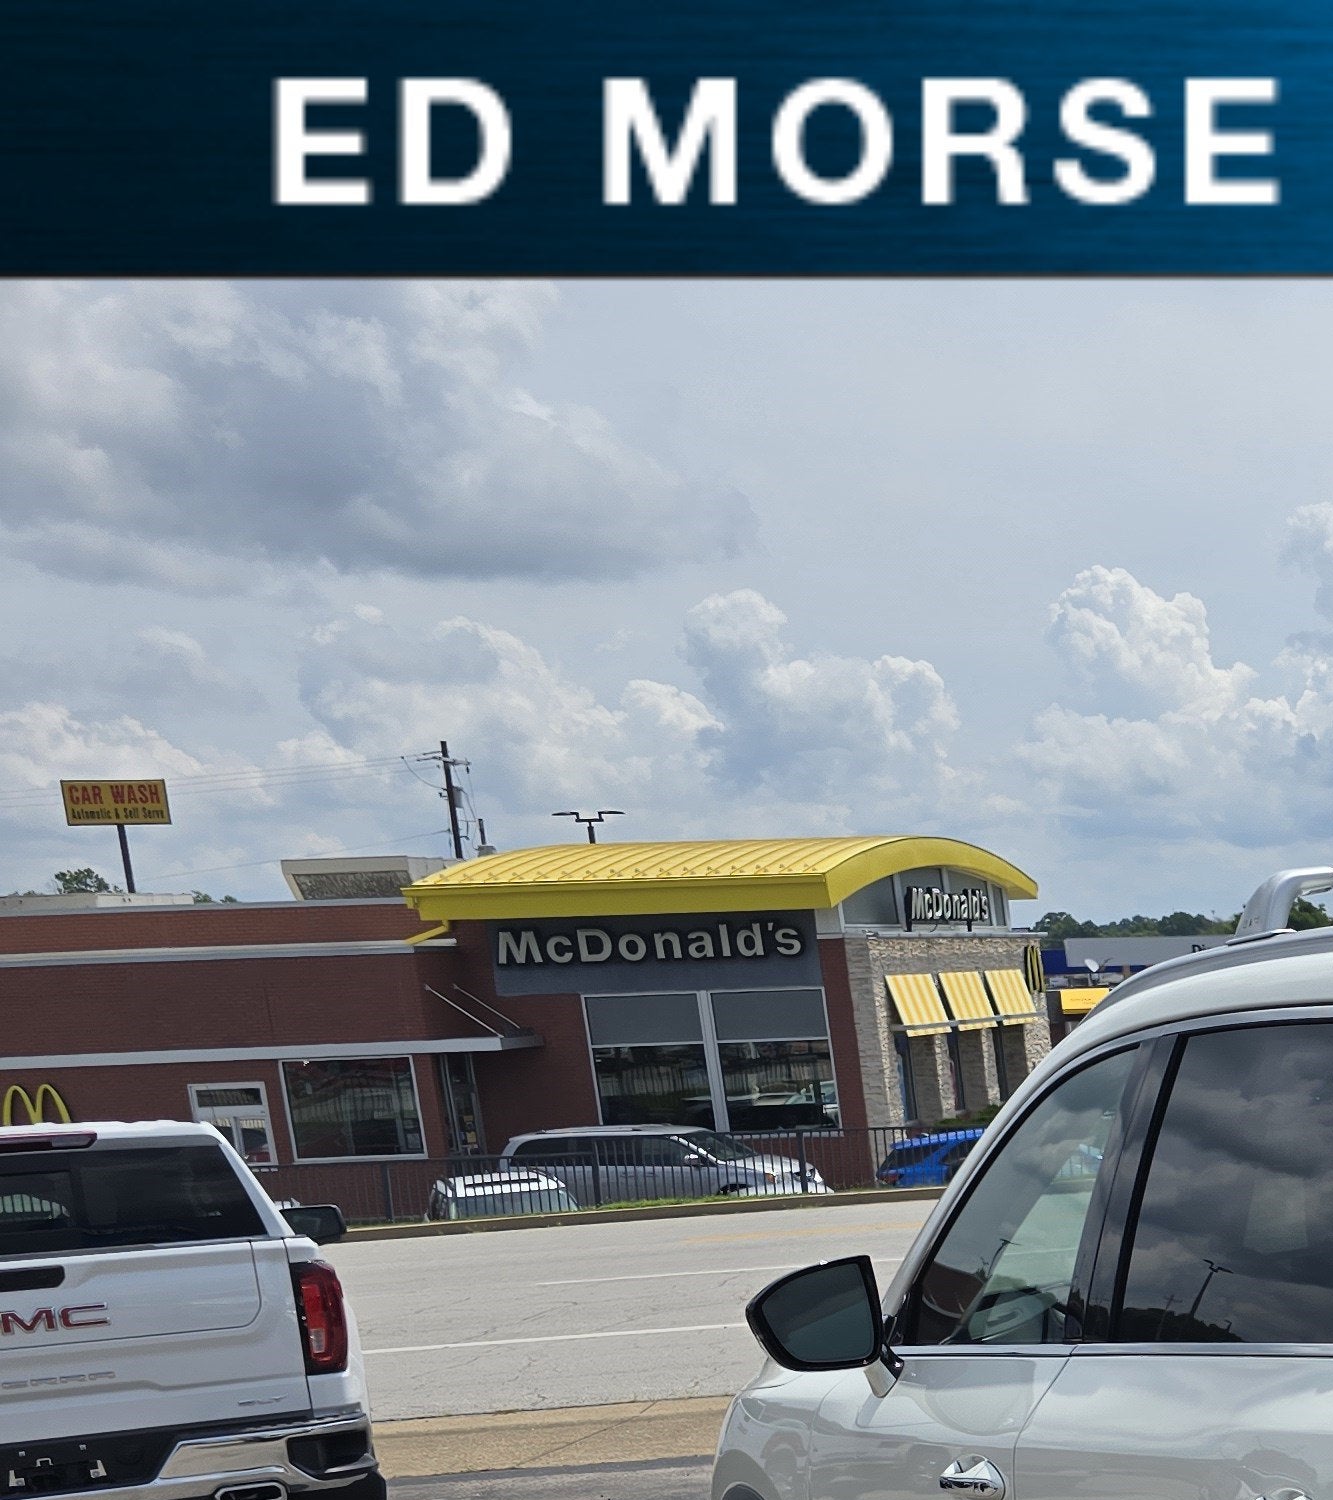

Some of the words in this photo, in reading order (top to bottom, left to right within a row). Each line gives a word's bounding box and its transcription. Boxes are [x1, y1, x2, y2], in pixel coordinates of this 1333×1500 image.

[68, 784, 104, 805] CAR
[109, 784, 160, 804] WASH
[72, 807, 112, 819] Automatic
[124, 806, 139, 819] Self
[143, 806, 164, 819] Serve
[911, 887, 989, 920] McDonald's
[498, 922, 802, 964] McDonald's
